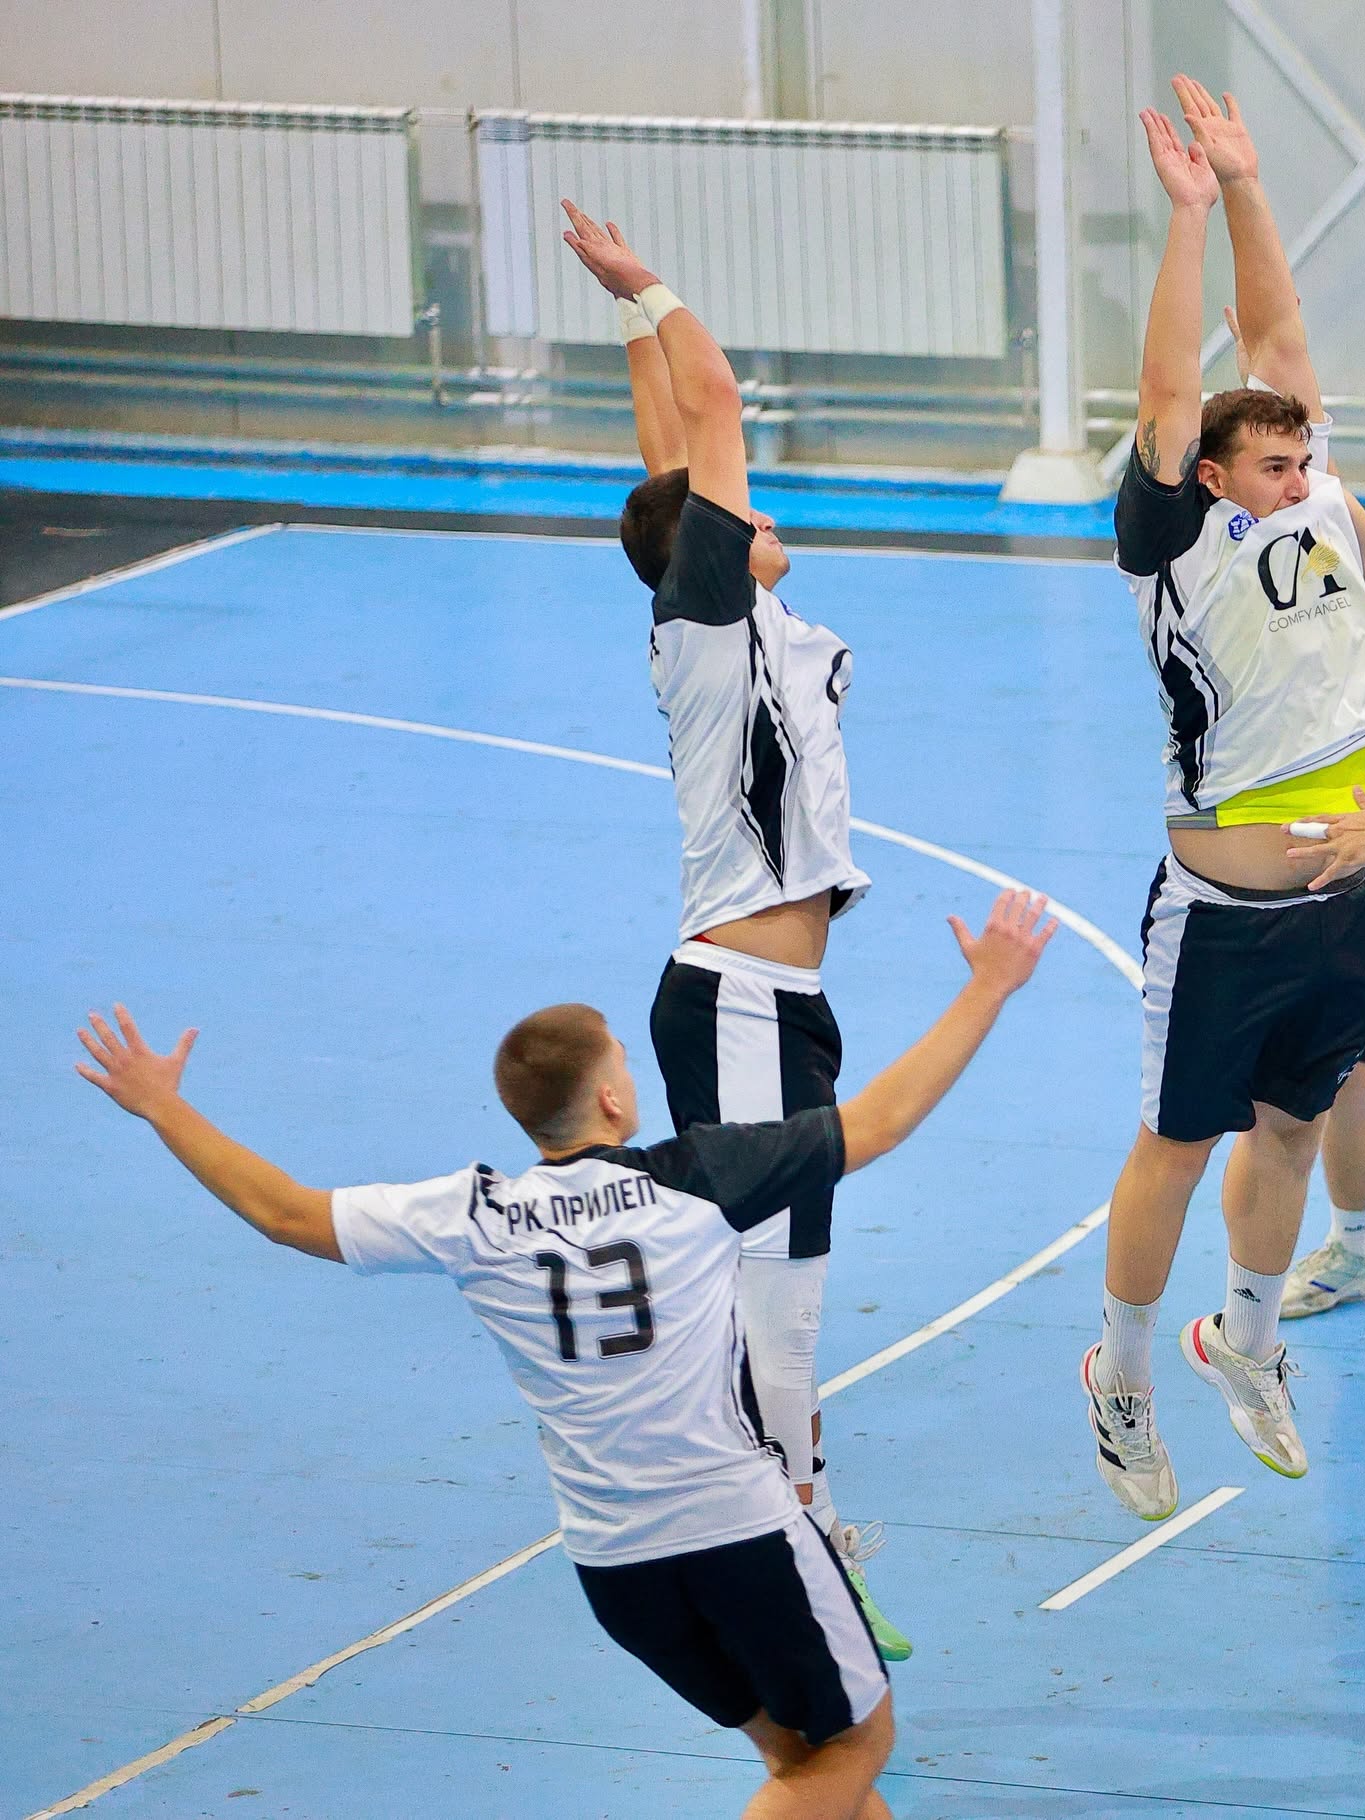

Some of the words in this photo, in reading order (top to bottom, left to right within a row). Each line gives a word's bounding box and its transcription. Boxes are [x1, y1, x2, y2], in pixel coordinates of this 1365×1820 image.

[1268, 608, 1313, 633] COMFY
[1314, 597, 1352, 617] ANGEL
[506, 1198, 543, 1235] РК
[550, 1174, 657, 1226] ПРИЛЕП
[534, 1239, 656, 1362] 13
